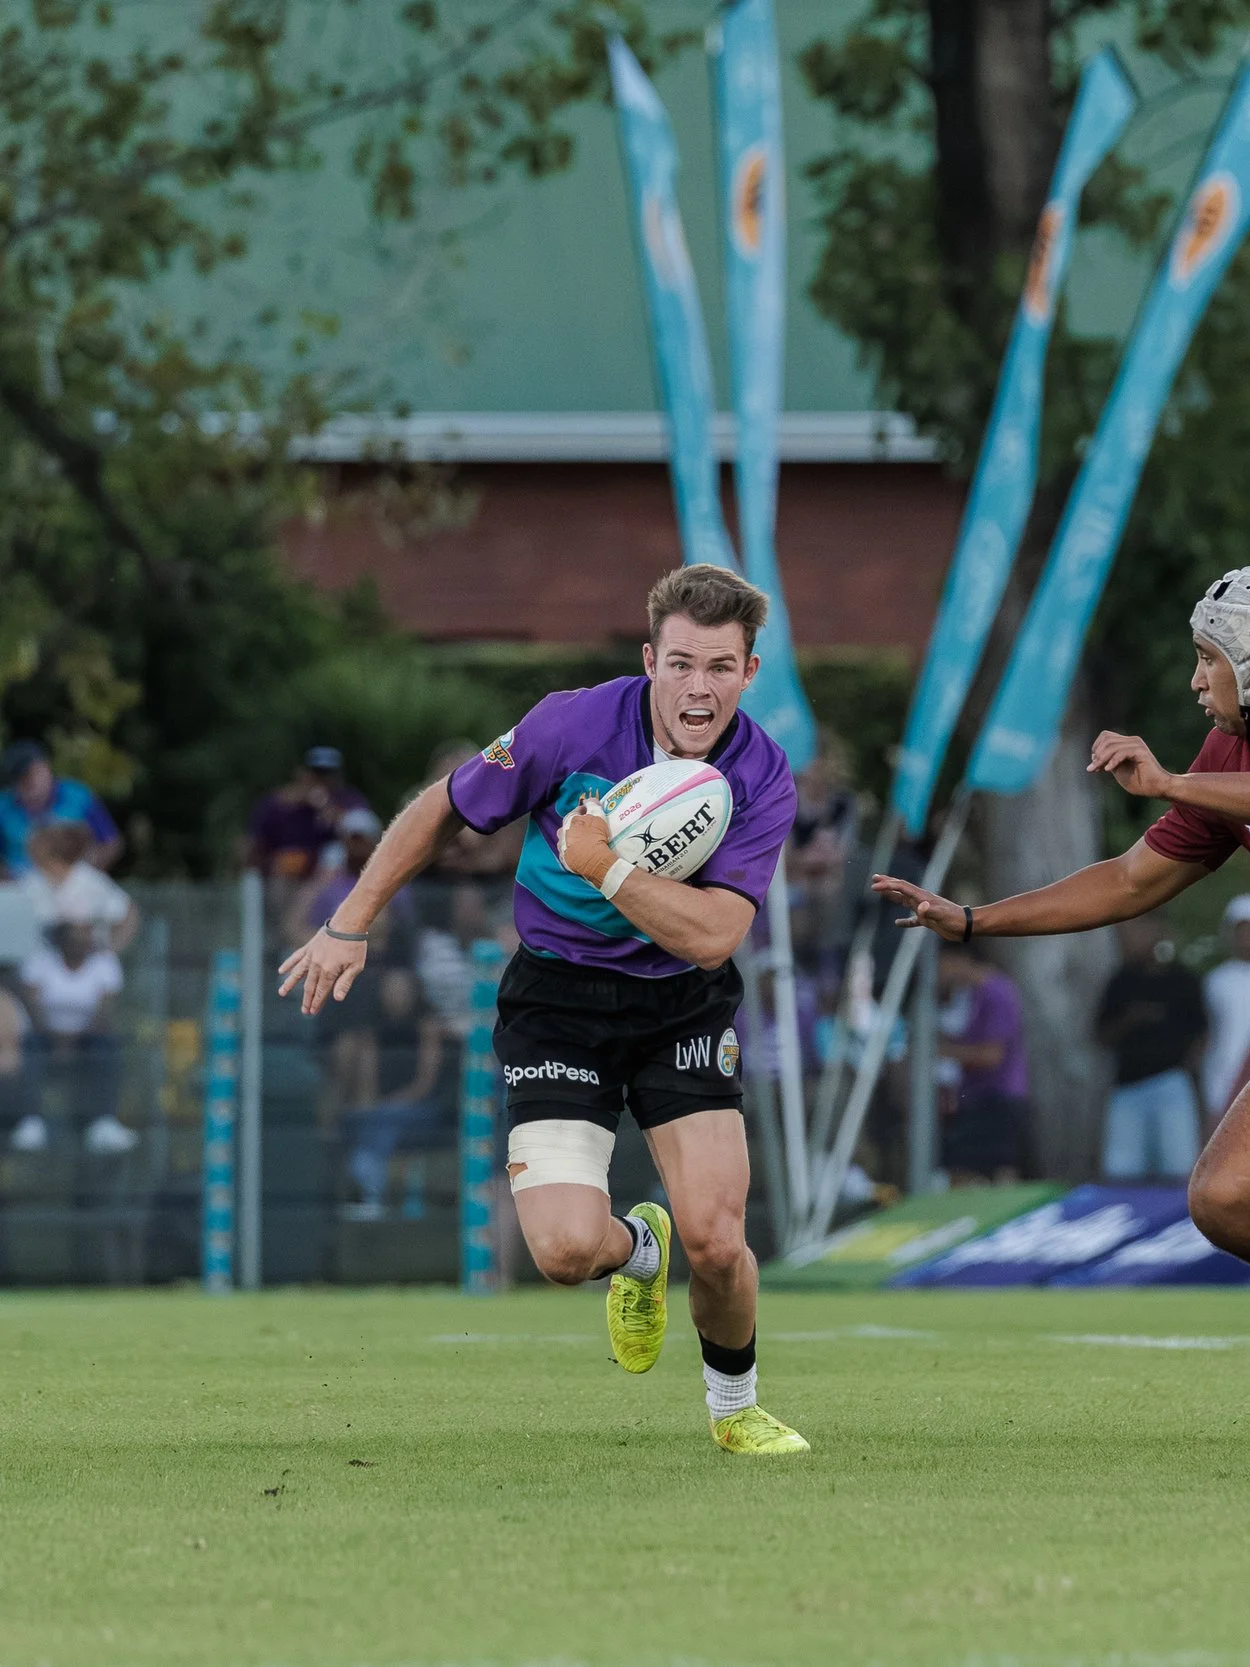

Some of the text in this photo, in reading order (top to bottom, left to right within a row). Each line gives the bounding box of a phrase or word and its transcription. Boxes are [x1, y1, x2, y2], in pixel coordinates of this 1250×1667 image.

[619, 802, 642, 821] 2026
[632, 803, 715, 873] BERT
[503, 1060, 600, 1087] SportPesa
